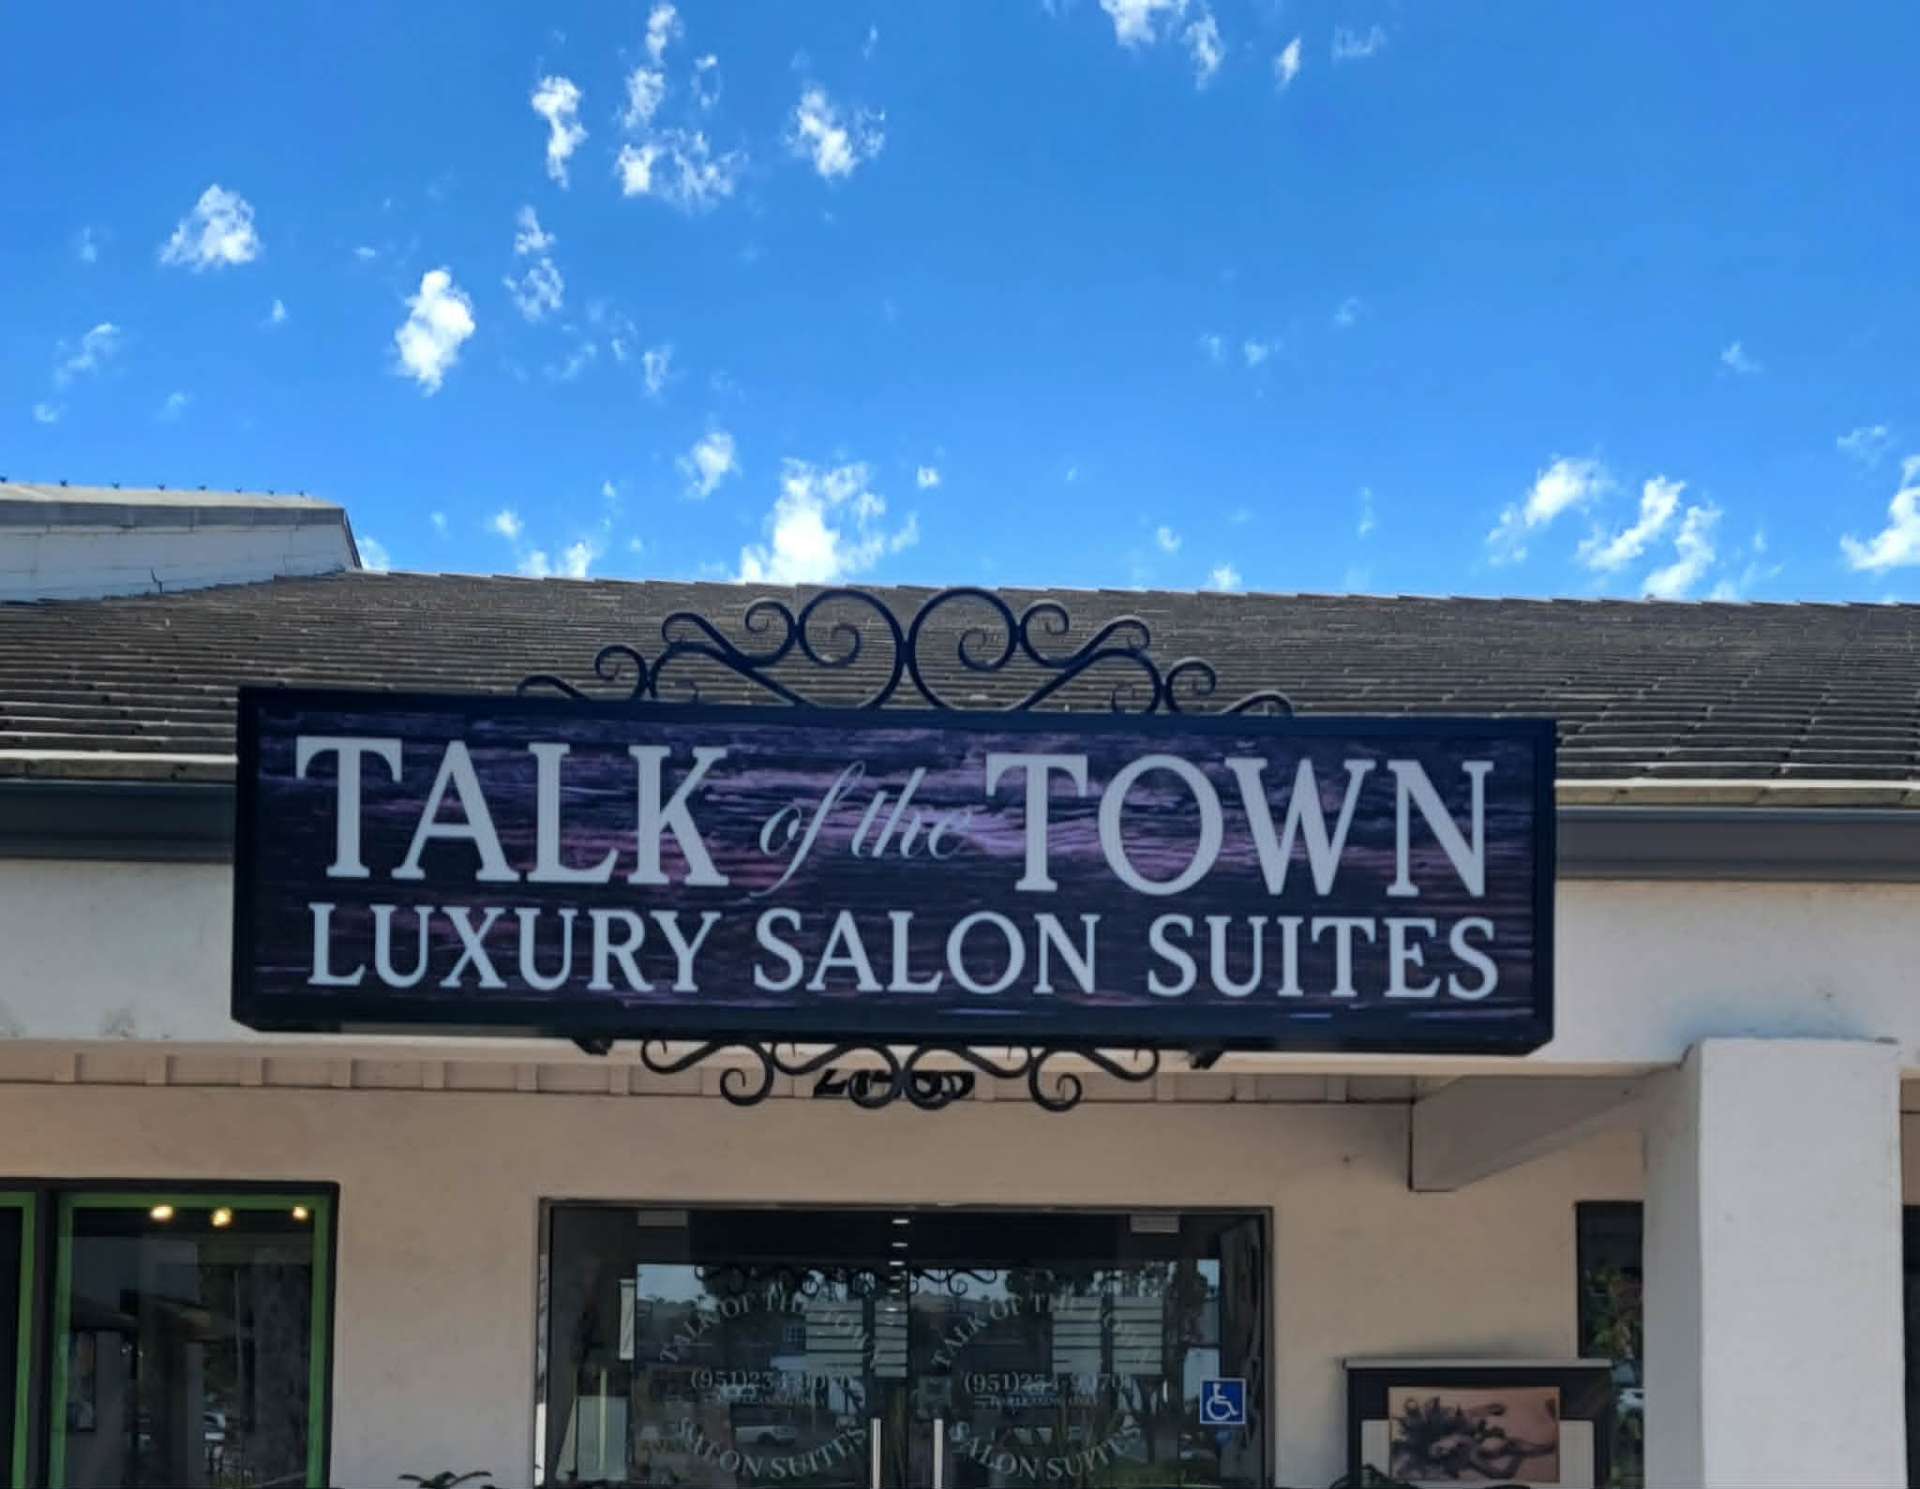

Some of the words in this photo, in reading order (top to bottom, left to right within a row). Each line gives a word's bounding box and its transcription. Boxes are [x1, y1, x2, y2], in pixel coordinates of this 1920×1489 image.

[295, 735, 730, 887] TALK
[748, 759, 866, 898] of
[851, 766, 972, 861] the
[985, 753, 1495, 897] TOWN
[307, 902, 721, 994] LUXURY
[753, 907, 1101, 995] SALON
[1146, 913, 1500, 1000] SUITES
